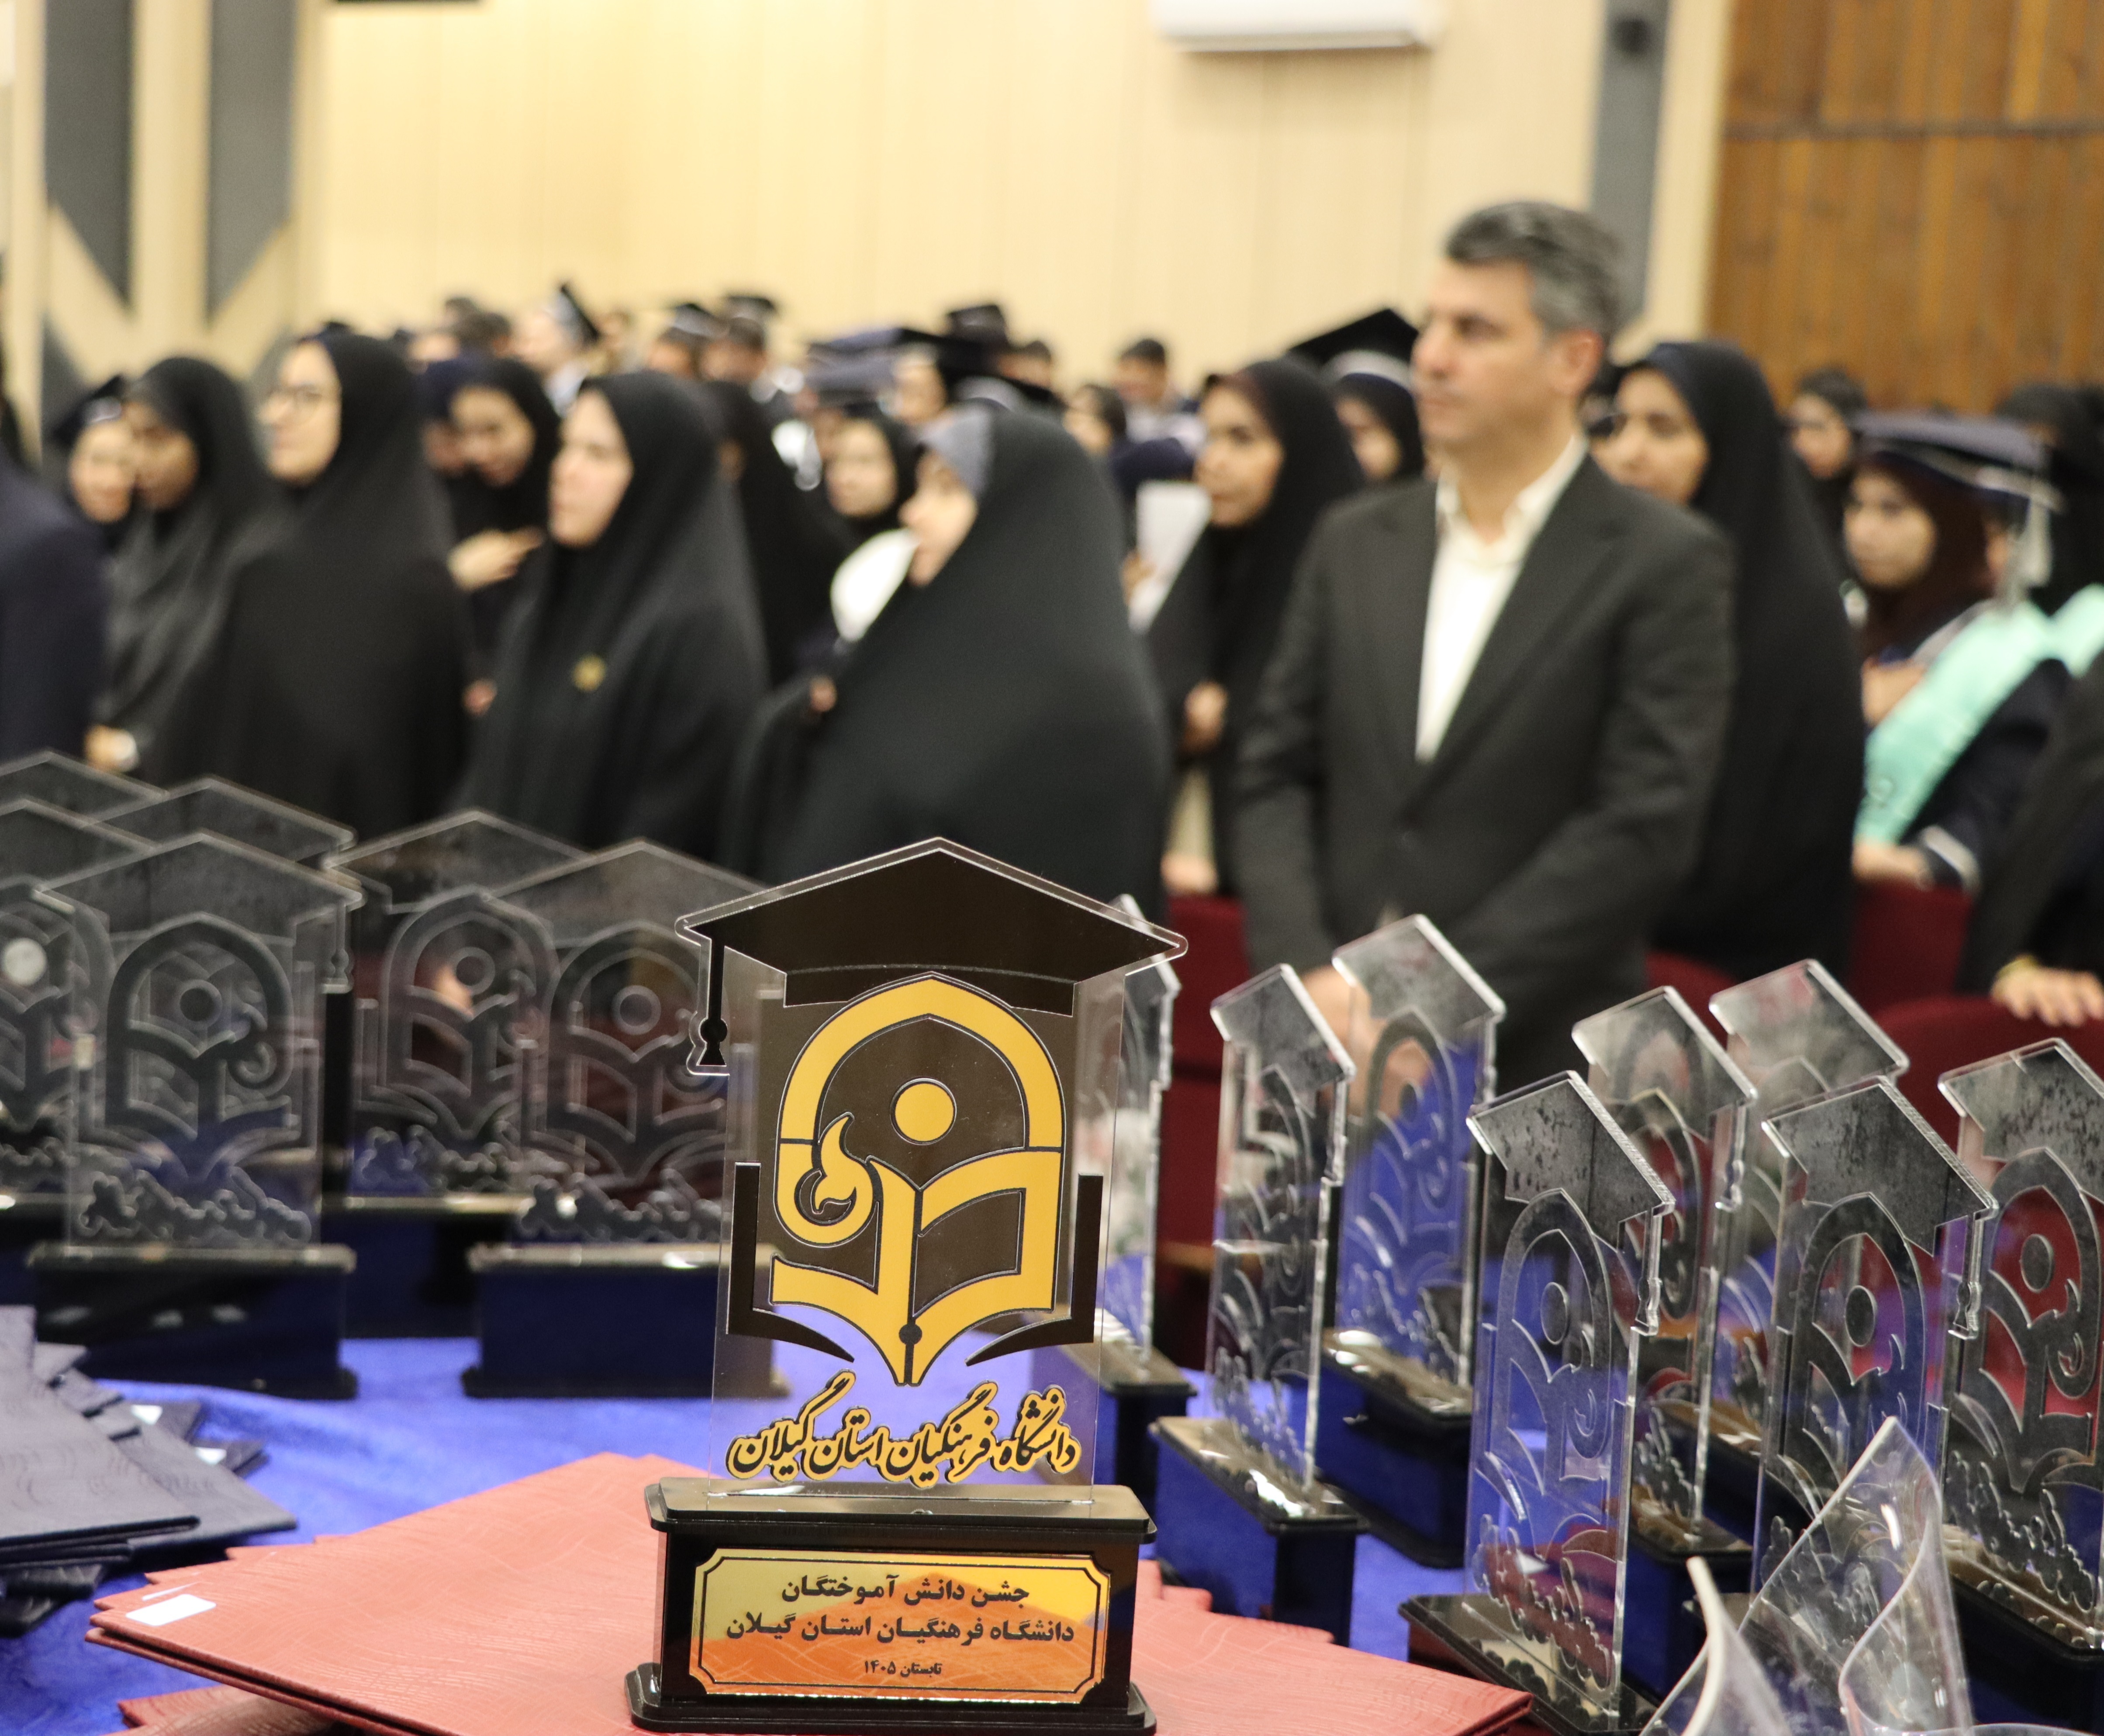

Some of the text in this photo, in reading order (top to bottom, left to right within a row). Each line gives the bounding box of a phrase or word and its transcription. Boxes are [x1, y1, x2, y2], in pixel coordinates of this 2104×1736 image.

[732, 1377, 1076, 1482] دانشگاه فرهنگیان استان گیلان
[781, 1574, 1030, 1609] جشن دانش آموختگان
[726, 1611, 1074, 1646] دانشگاه فرهنگیان استان گیلان
[864, 1659, 943, 1678] تابستان ۱۴۰۵
